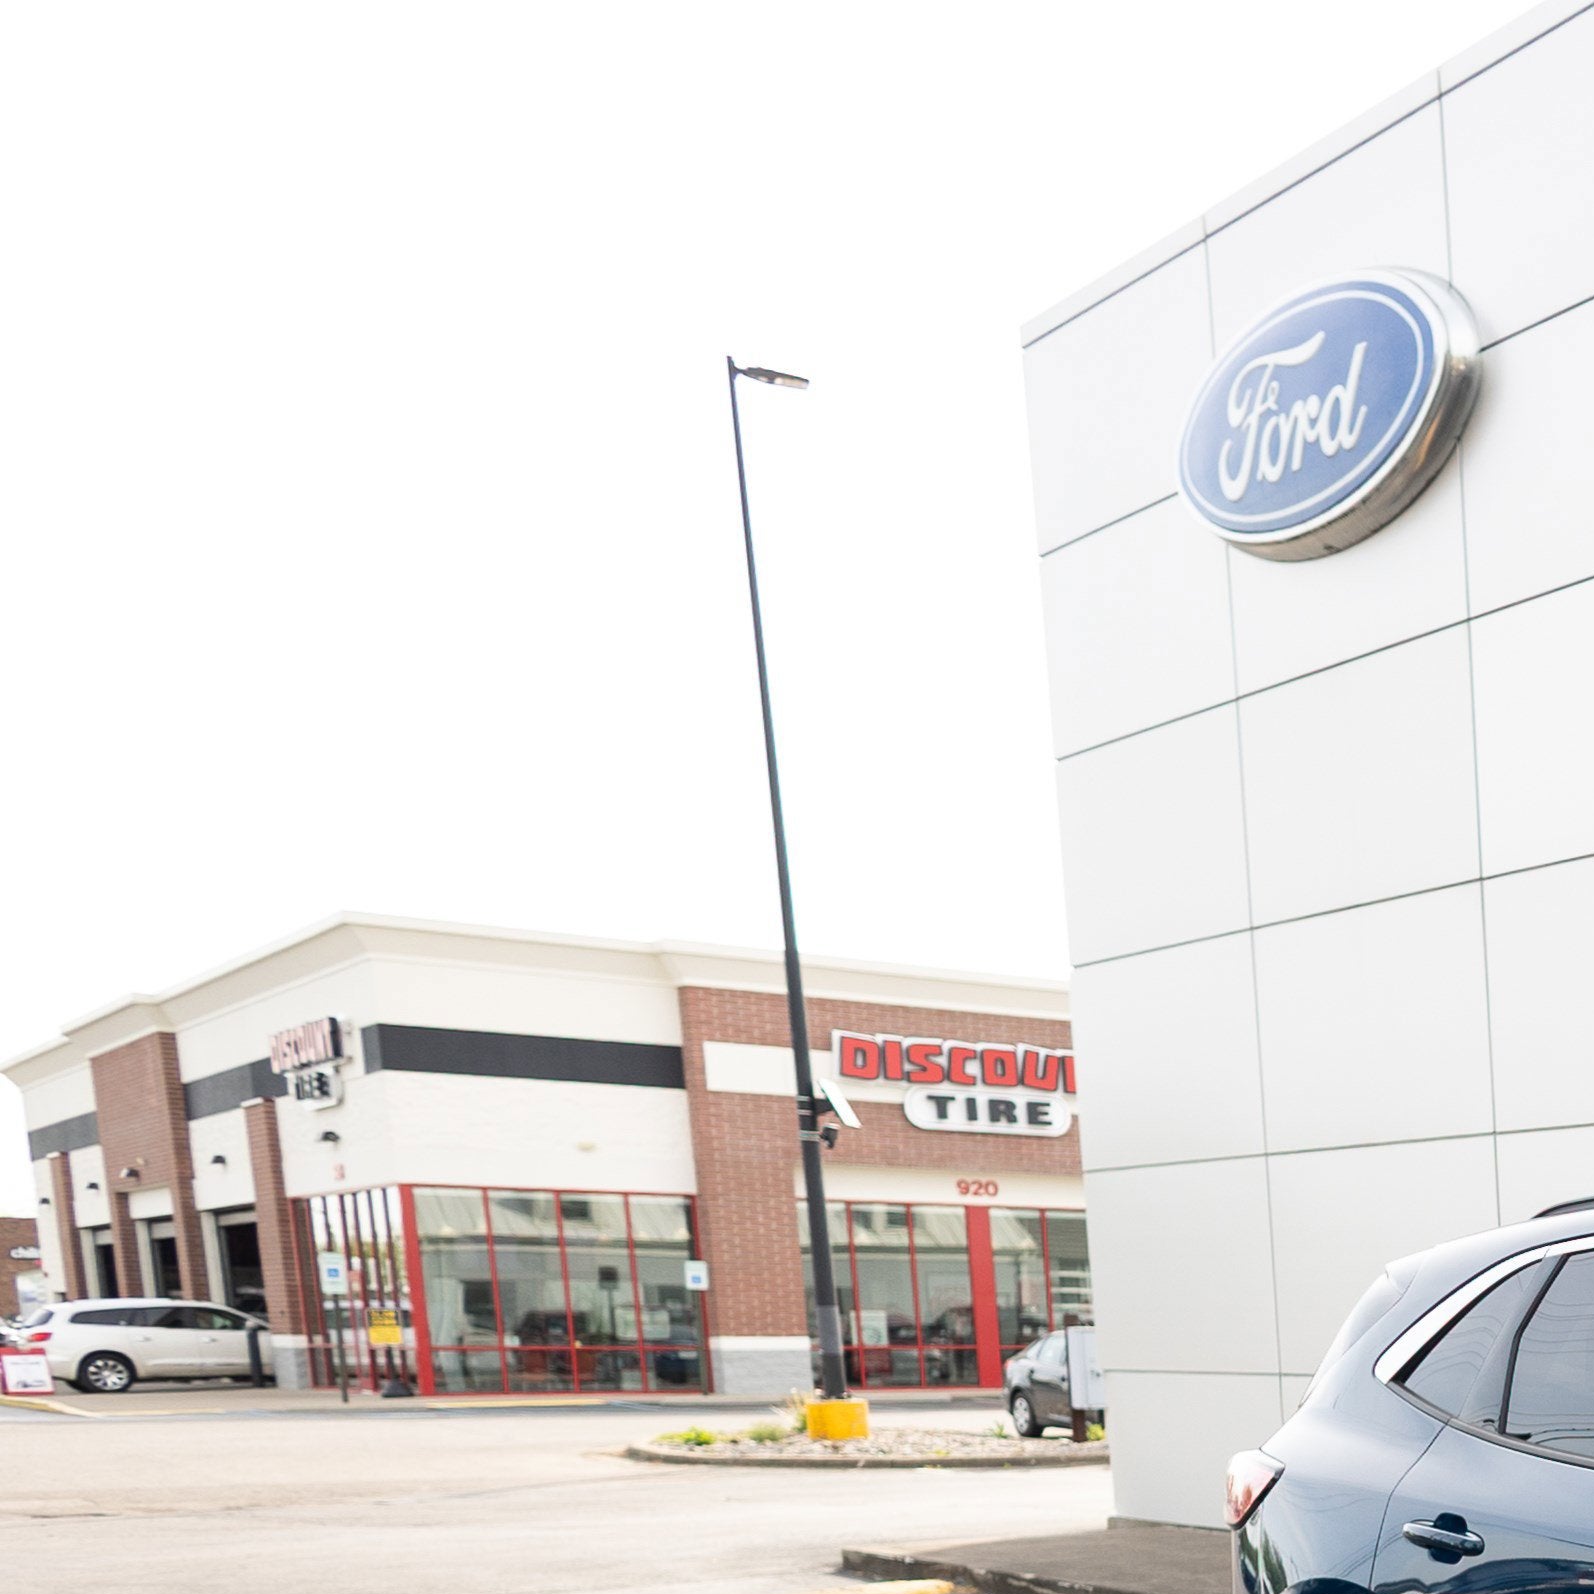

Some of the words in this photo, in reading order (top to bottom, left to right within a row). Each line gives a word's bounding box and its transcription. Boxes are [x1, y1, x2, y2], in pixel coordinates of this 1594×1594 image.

[1217, 329, 1368, 502] Ford
[839, 1035, 1077, 1095] DISCOU
[926, 1094, 1053, 1126] TIRE
[956, 1178, 999, 1197] 920
